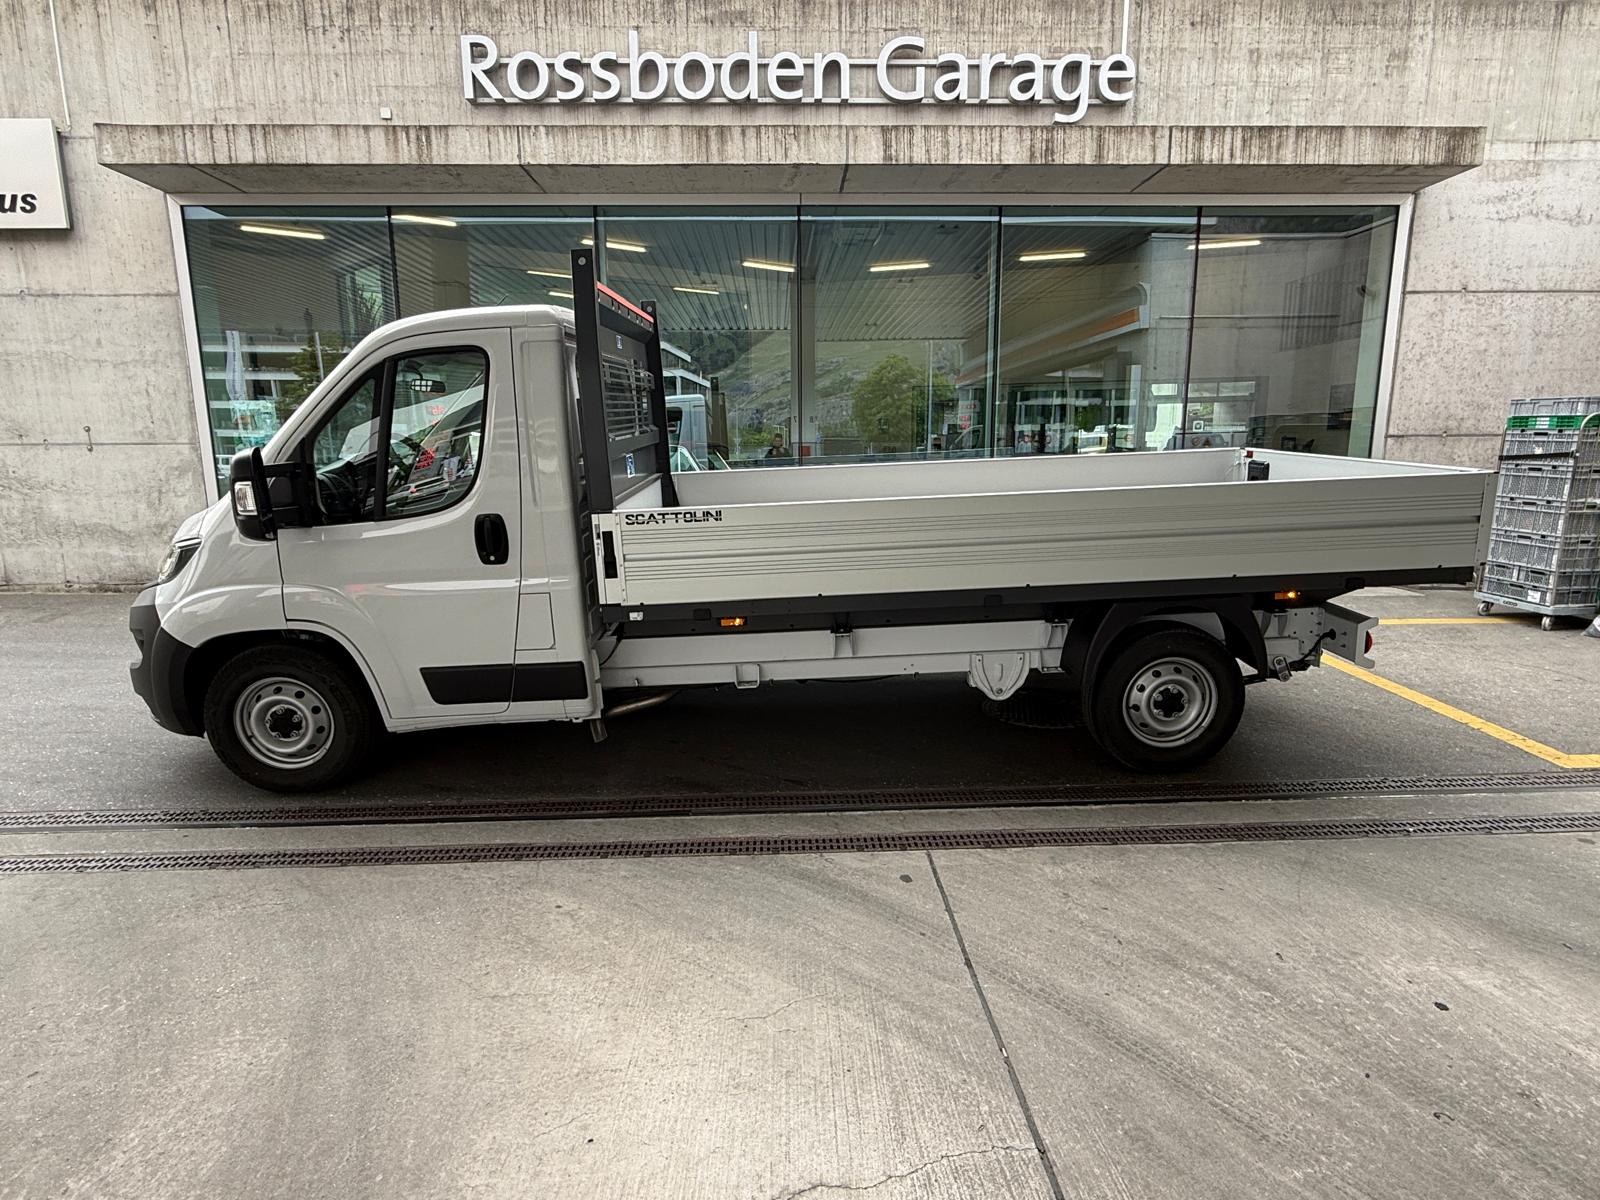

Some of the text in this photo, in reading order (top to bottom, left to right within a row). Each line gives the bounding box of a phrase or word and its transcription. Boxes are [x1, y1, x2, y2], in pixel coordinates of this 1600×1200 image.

[460, 29, 1136, 125] Rossboden Garage
[624, 509, 723, 526] SCATTOLINI
